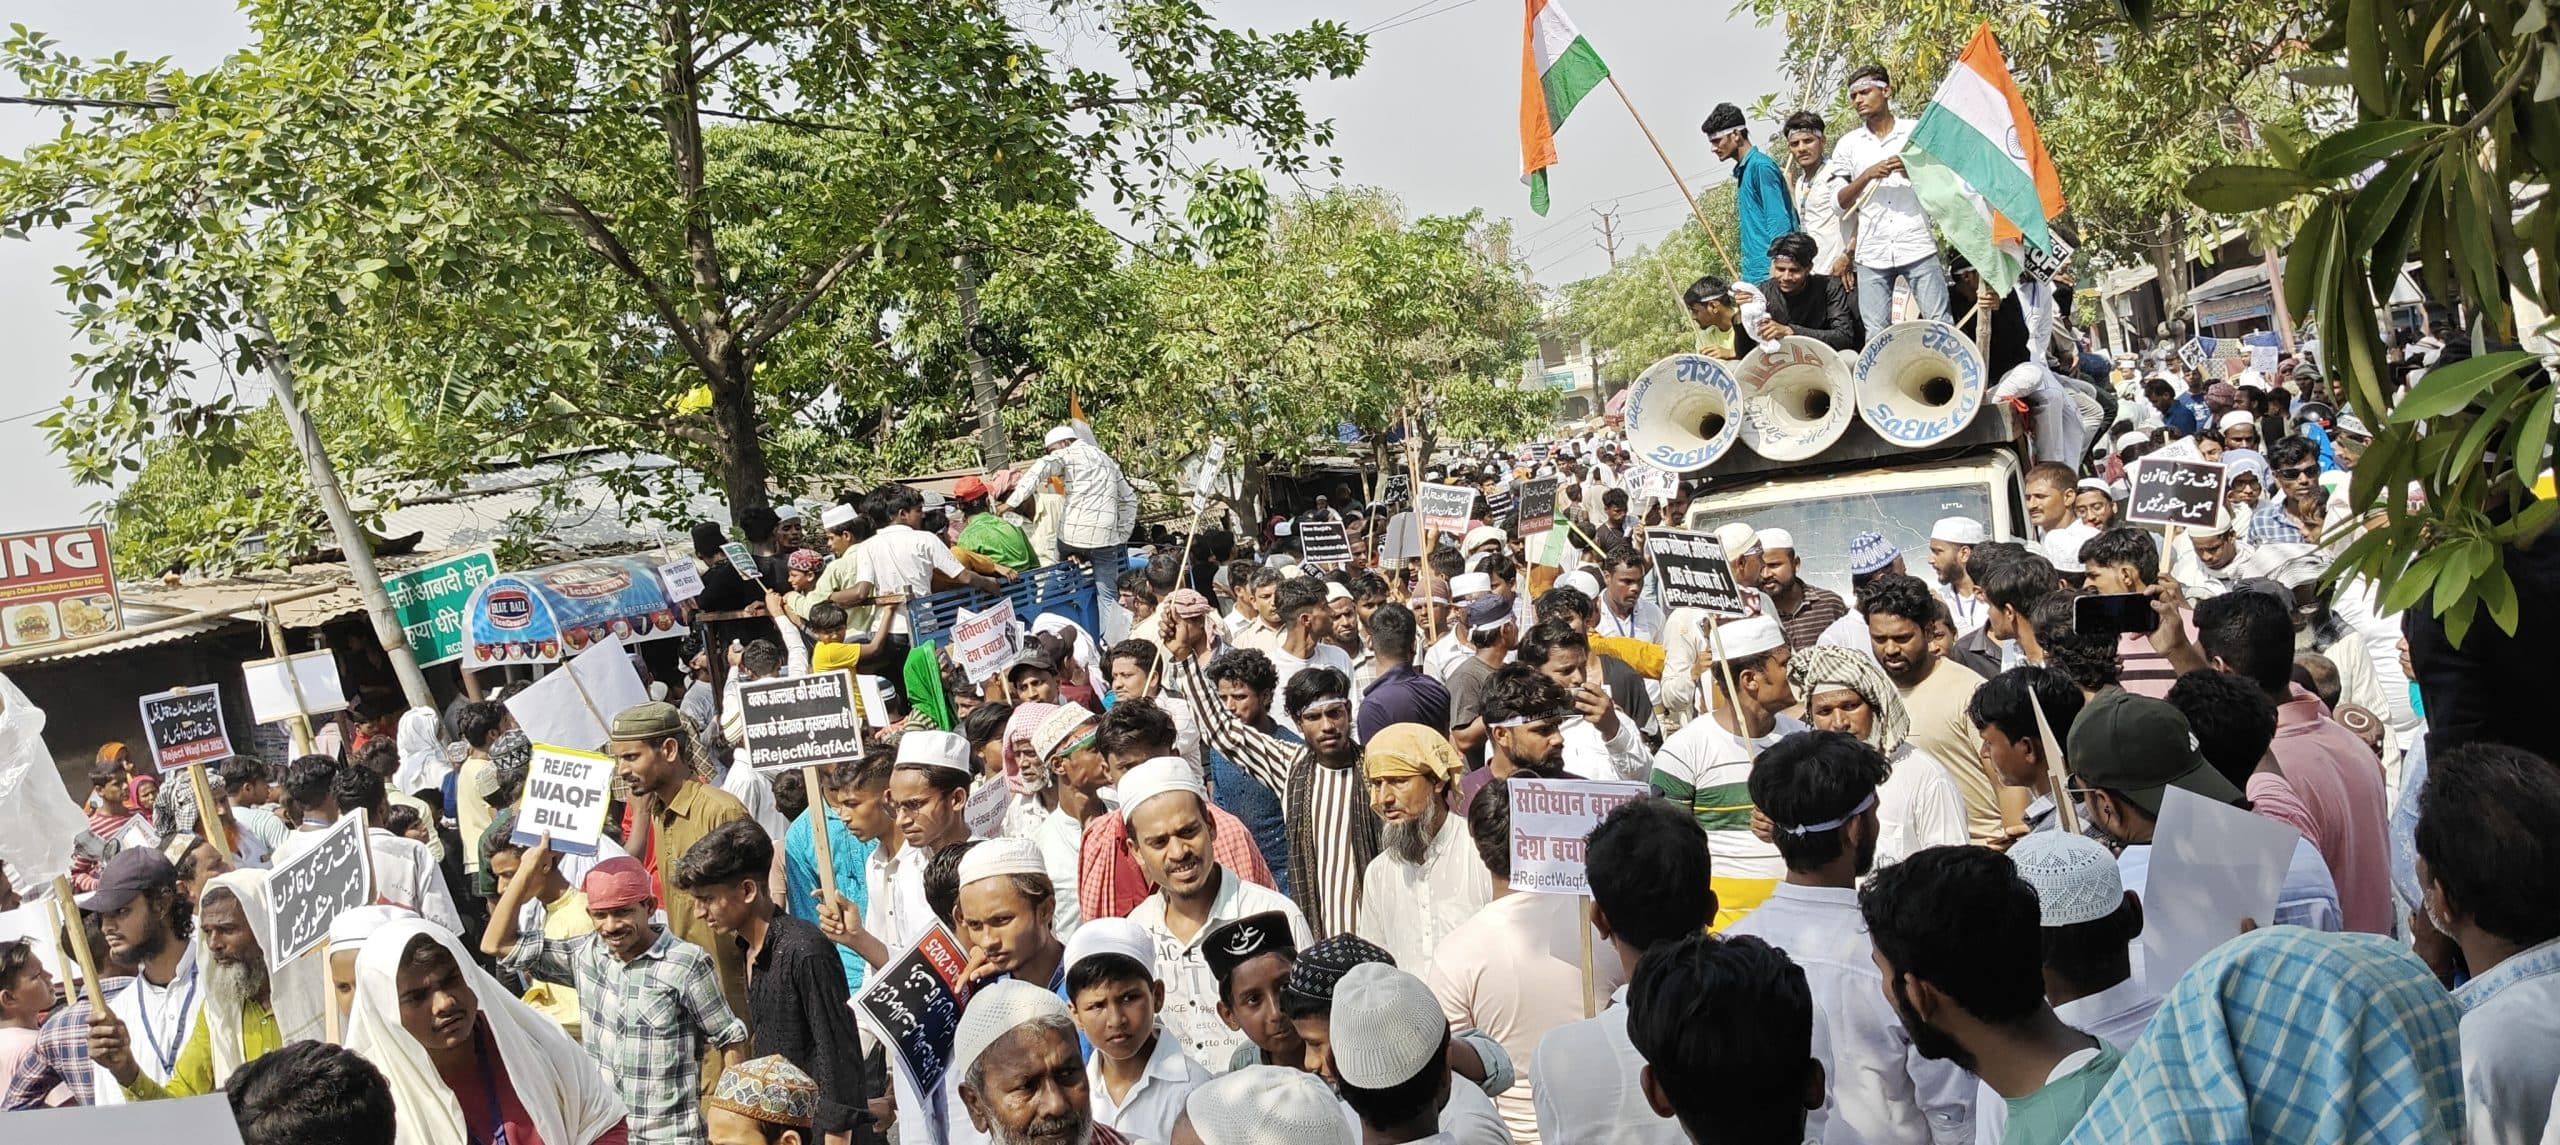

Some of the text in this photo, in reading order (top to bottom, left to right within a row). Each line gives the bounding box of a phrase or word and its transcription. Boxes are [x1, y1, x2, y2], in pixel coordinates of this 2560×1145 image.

[2141, 468, 2169, 484] قانون
[2193, 473, 2219, 489] وقف
[415, 567, 463, 601] आबादी
[464, 562, 489, 587] क्षेत्र
[492, 601, 527, 613] BLUE BALL
[435, 606, 462, 634] धीरे
[964, 648, 981, 662] देश
[795, 680, 808, 700] की
[767, 716, 776, 736] के
[162, 747, 185, 762] Reject
[752, 738, 857, 763] #RejectWaqfAct
[543, 758, 593, 780] REJECT
[530, 779, 602, 809] WAQF
[534, 808, 578, 831] BILL
[1515, 828, 1546, 861] देश
[1512, 871, 1589, 890] #RejectWaqfA
[924, 937, 952, 967] 2025
